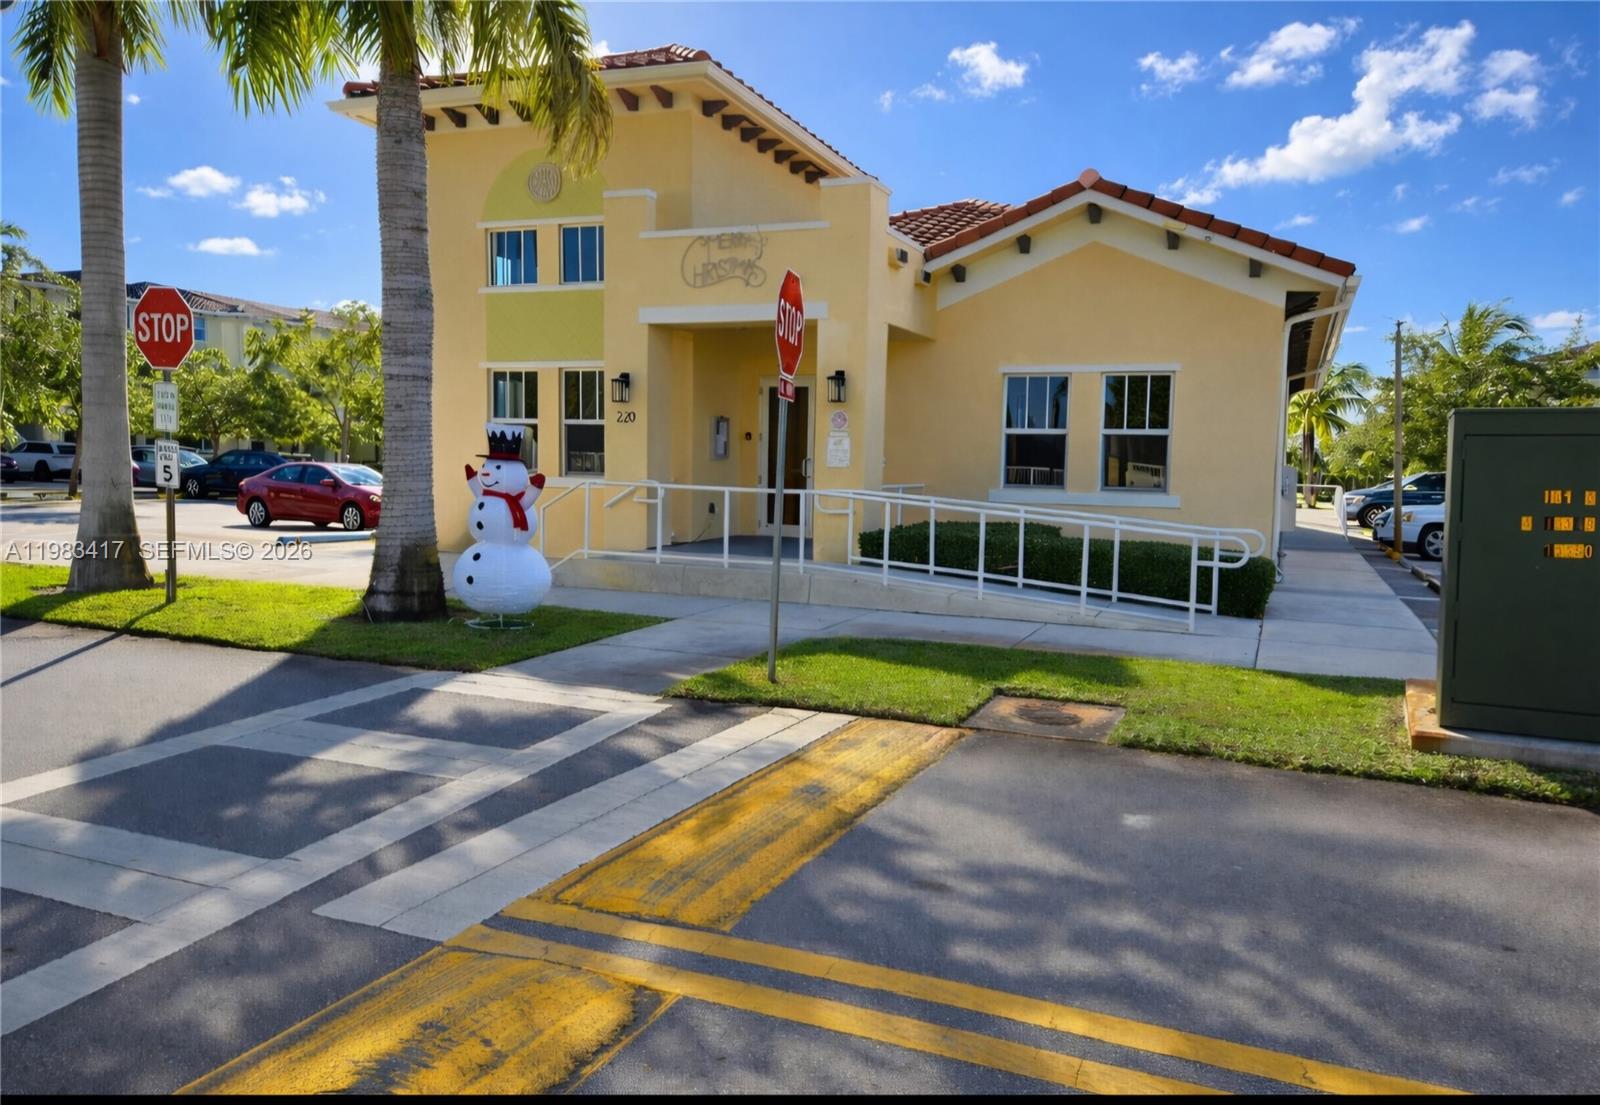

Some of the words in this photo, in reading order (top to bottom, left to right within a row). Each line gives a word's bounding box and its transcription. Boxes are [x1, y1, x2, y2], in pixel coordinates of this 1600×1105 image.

[138, 312, 189, 343] STOP
[778, 298, 803, 347] STOP
[616, 411, 636, 424] 220
[163, 465, 173, 482] 5
